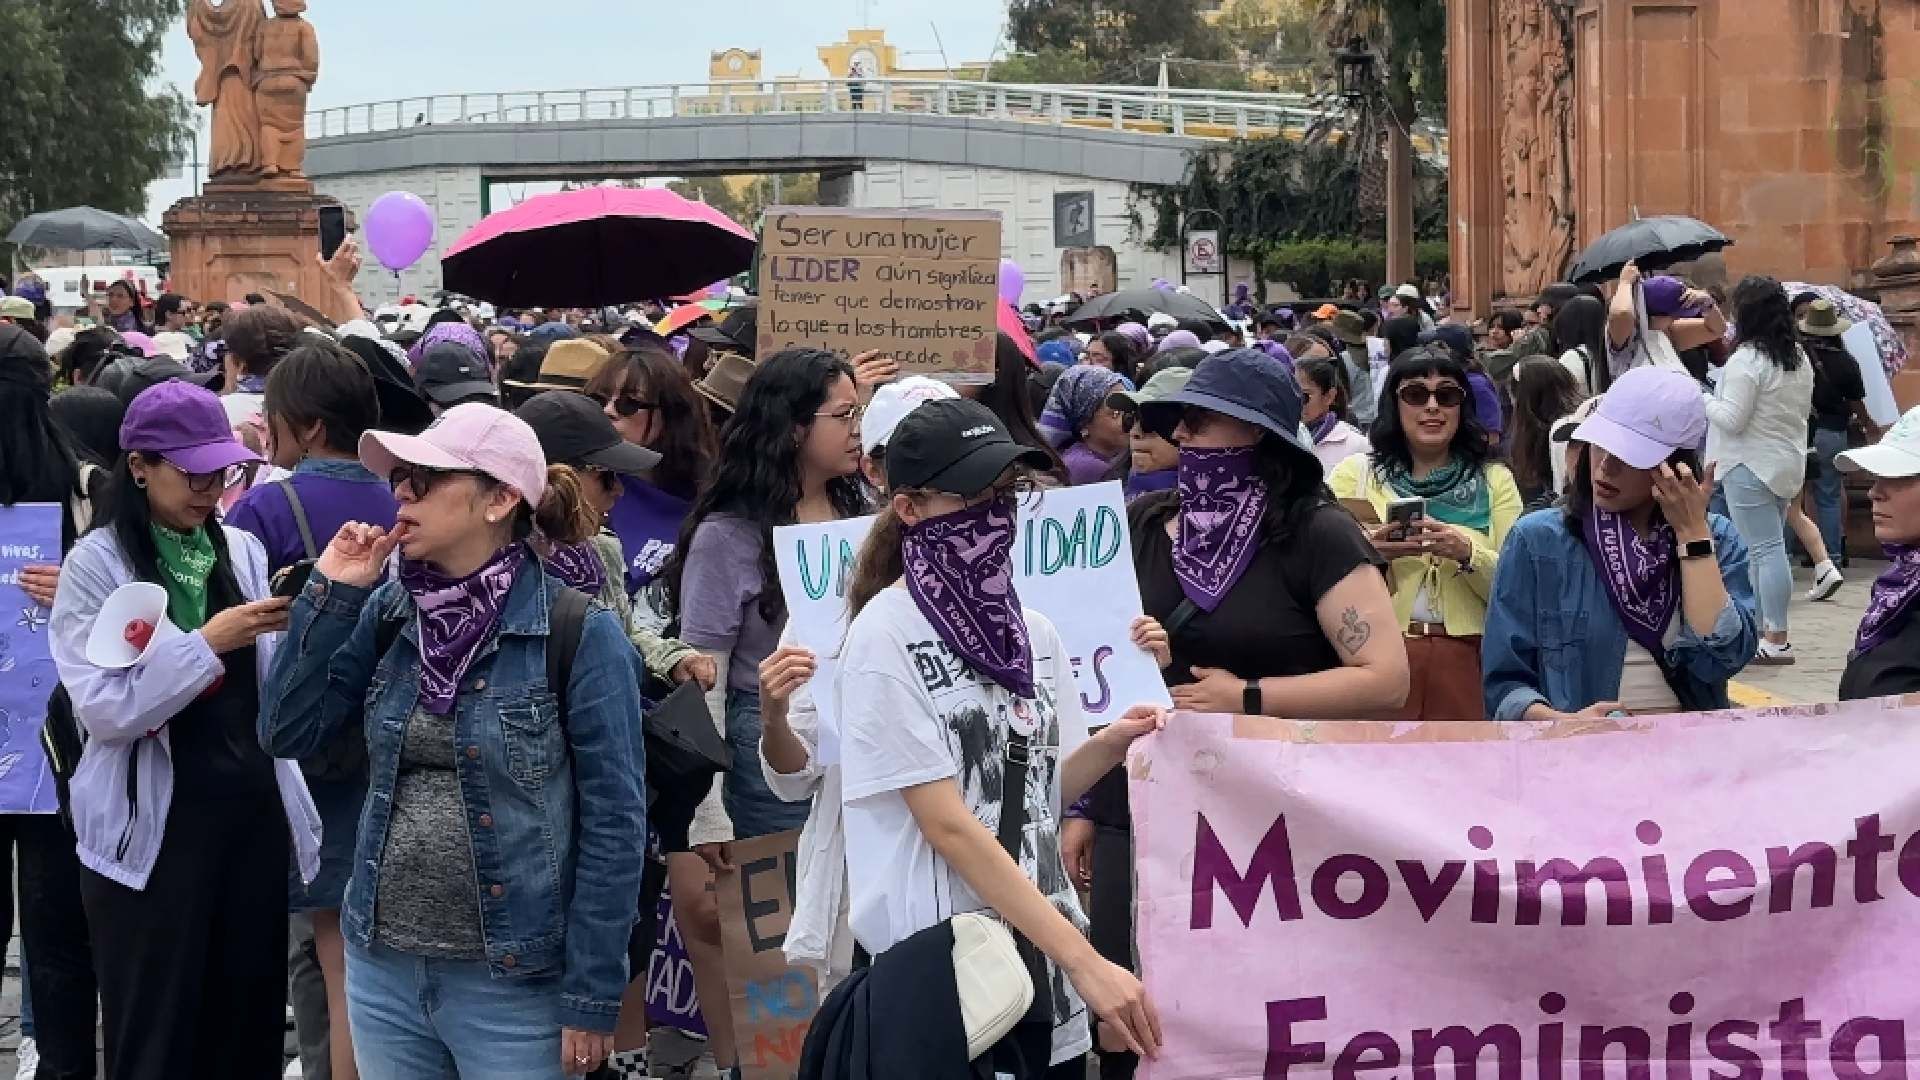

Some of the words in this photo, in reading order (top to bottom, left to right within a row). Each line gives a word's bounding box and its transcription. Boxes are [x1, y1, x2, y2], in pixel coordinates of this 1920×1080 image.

[776, 213, 838, 246] Ser
[845, 231, 896, 249] una
[902, 227, 977, 260] mujer
[770, 255, 861, 283] LIDER
[769, 284, 826, 304] tener
[834, 294, 869, 314] que
[879, 288, 988, 311] demostrar
[770, 309, 790, 333] lo
[796, 318, 829, 338] que
[837, 322, 849, 337] a
[855, 317, 886, 337] los
[891, 317, 985, 340] hombres
[1190, 811, 1920, 930] Movimient
[1264, 992, 1908, 1080] Feminista
